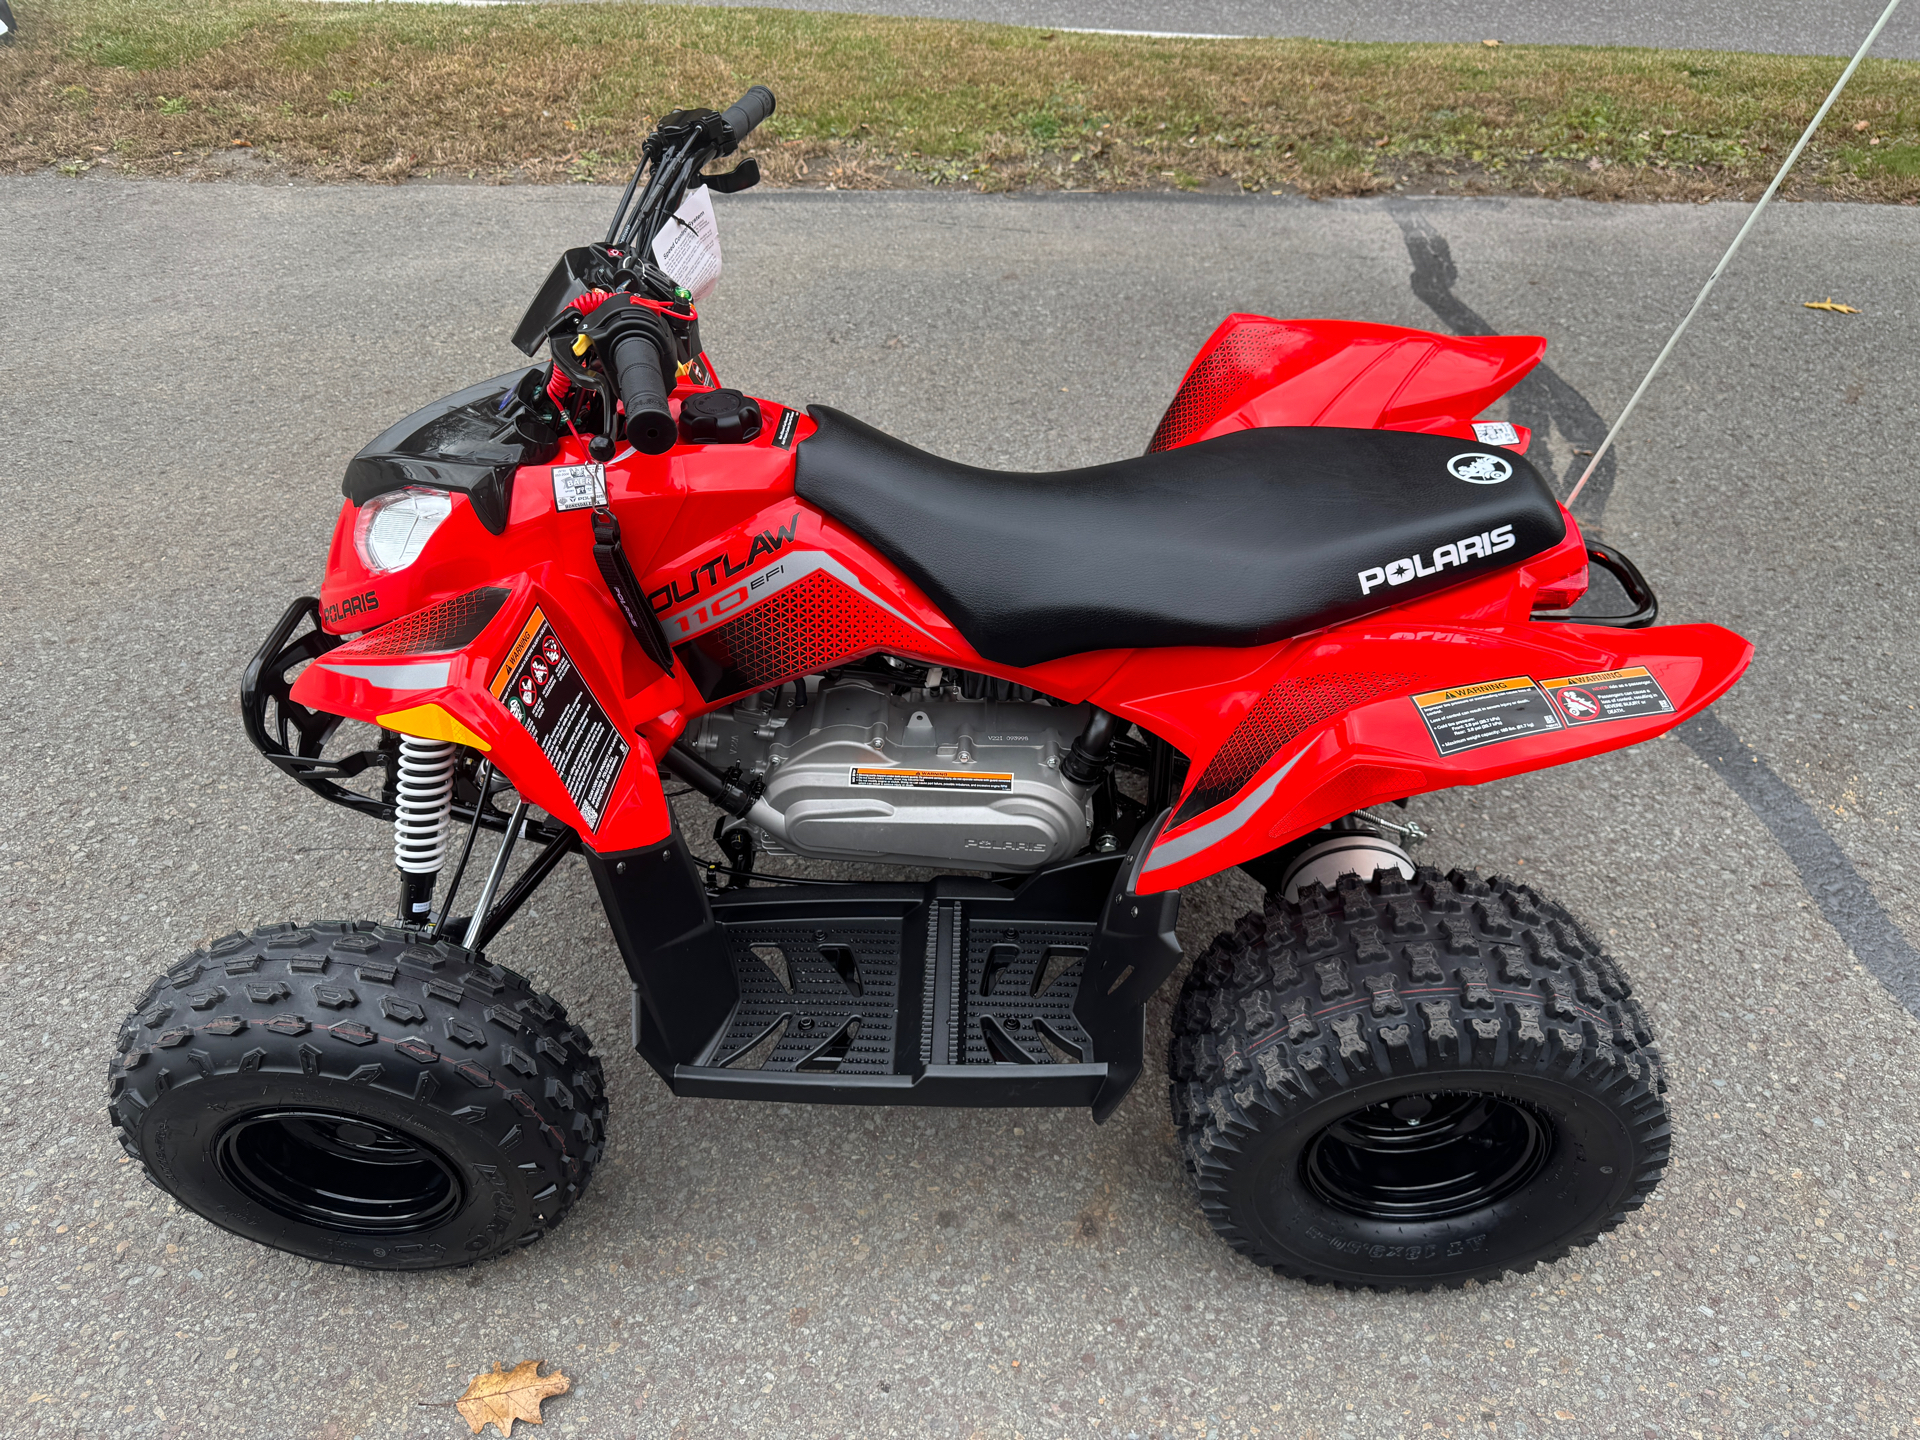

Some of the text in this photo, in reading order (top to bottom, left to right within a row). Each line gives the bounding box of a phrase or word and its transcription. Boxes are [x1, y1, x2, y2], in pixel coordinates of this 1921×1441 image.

[663, 242, 676, 259] Speed
[688, 210, 705, 226] System
[647, 512, 800, 614] OUTLAW
[1358, 524, 1516, 595] POLARIS
[324, 590, 379, 626] POLARIS
[674, 565, 784, 632] 110 EFI
[510, 631, 530, 664] WARNING
[1455, 682, 1508, 696] WARNING
[1576, 672, 1622, 684] WARNING
[964, 838, 1046, 853] POLARIS
